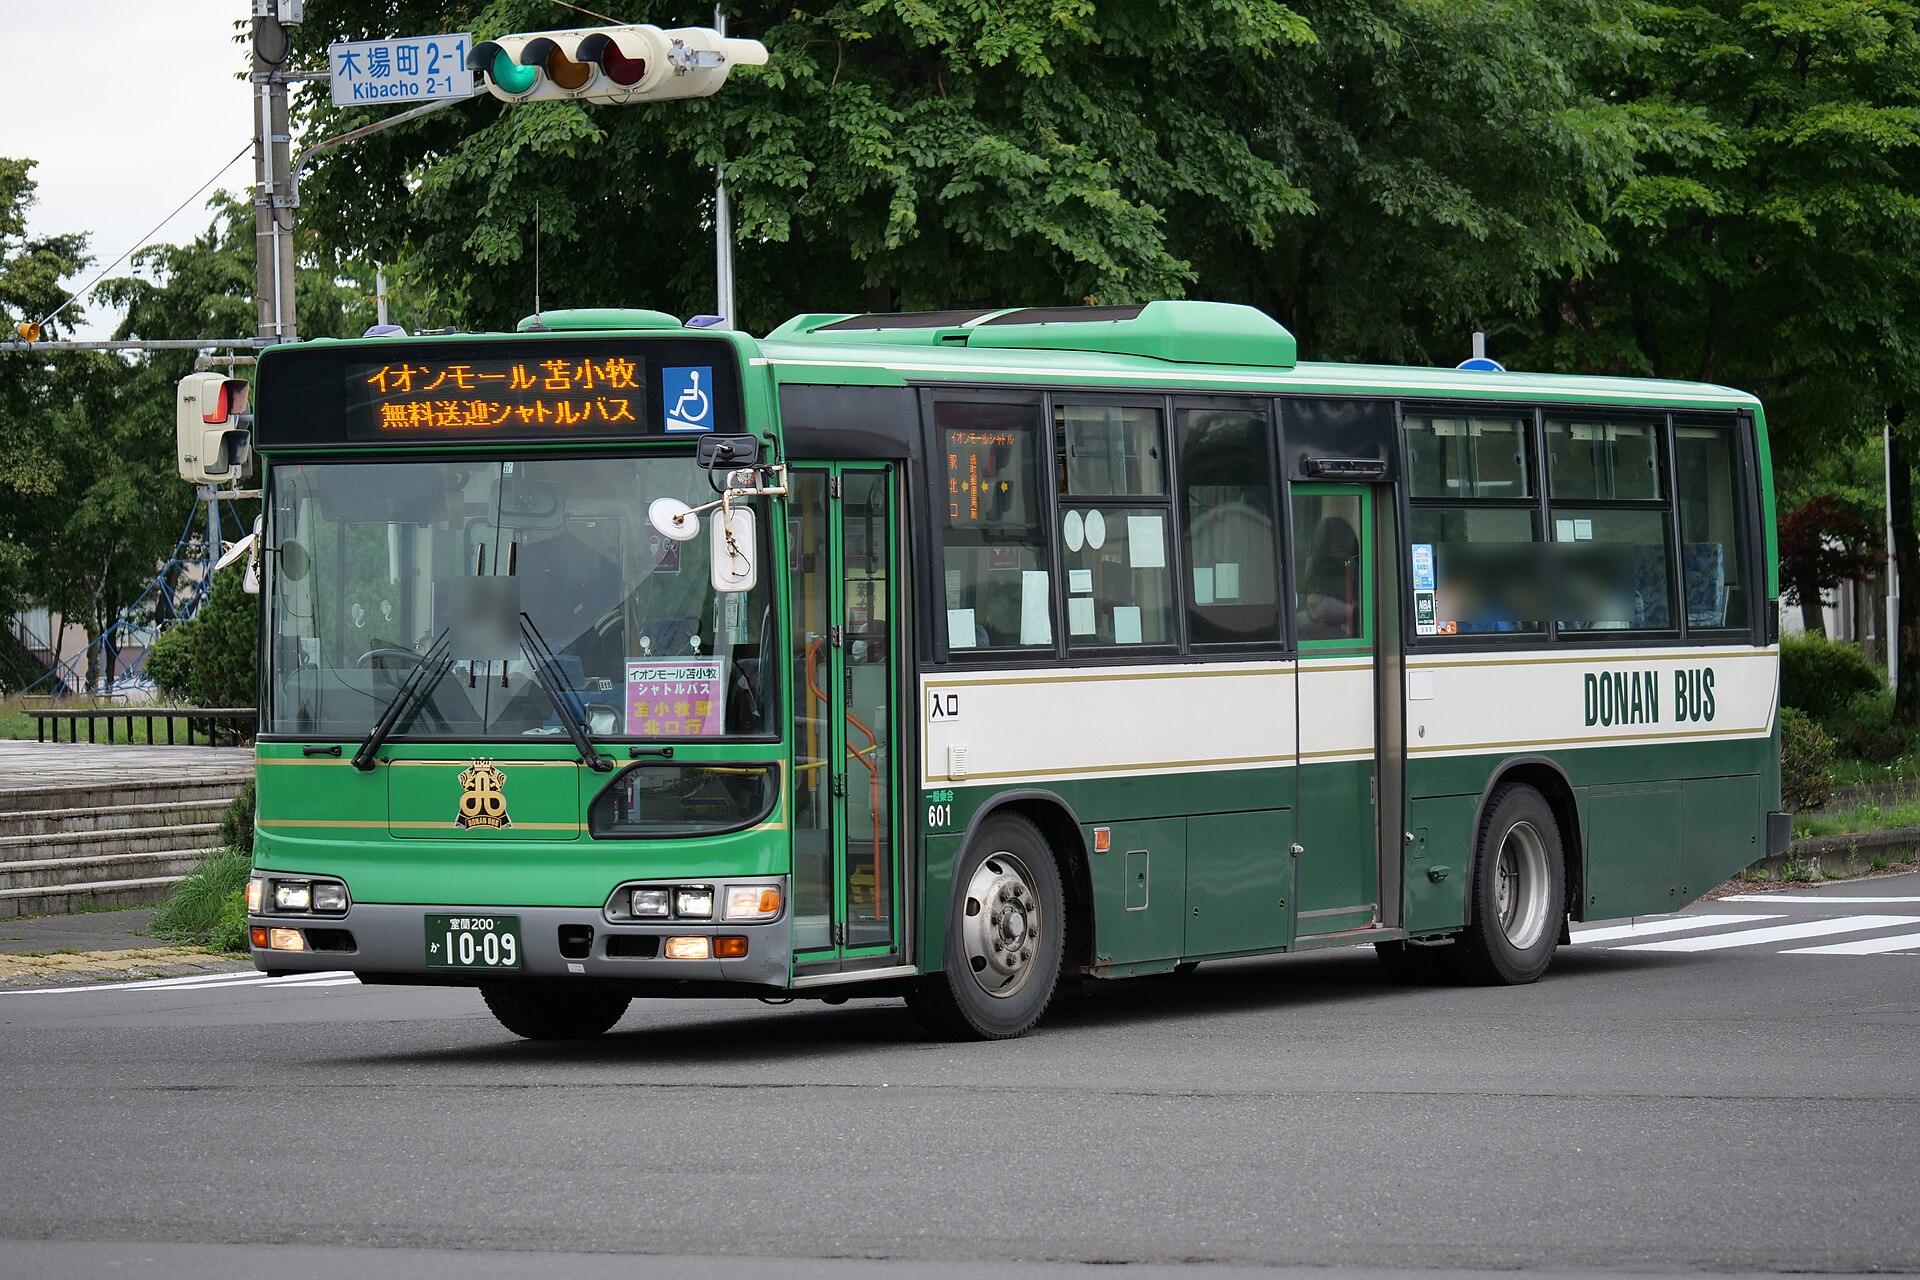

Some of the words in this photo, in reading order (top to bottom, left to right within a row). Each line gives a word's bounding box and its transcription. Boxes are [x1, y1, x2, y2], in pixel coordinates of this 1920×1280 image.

[338, 39, 465, 81] 木場町2-1
[353, 80, 419, 99] Kibacho
[426, 76, 451, 94] 2-1
[367, 358, 640, 392] イオンモール苫小牧
[381, 396, 636, 428] 無料送迎シャトルバス
[630, 668, 717, 681] イオンモール苫小牧
[638, 683, 711, 696] シャトルバス
[1584, 671, 1659, 728] DONAN
[1674, 667, 1715, 722] BUS
[634, 700, 713, 717] 苫小牧駅
[932, 694, 959, 718] 入口
[643, 719, 702, 735] 北口行
[925, 790, 954, 802] 一般乗合
[487, 817, 500, 827] BUS
[928, 804, 951, 828] 601
[430, 942, 440, 953] か
[446, 931, 516, 965] 10-09
